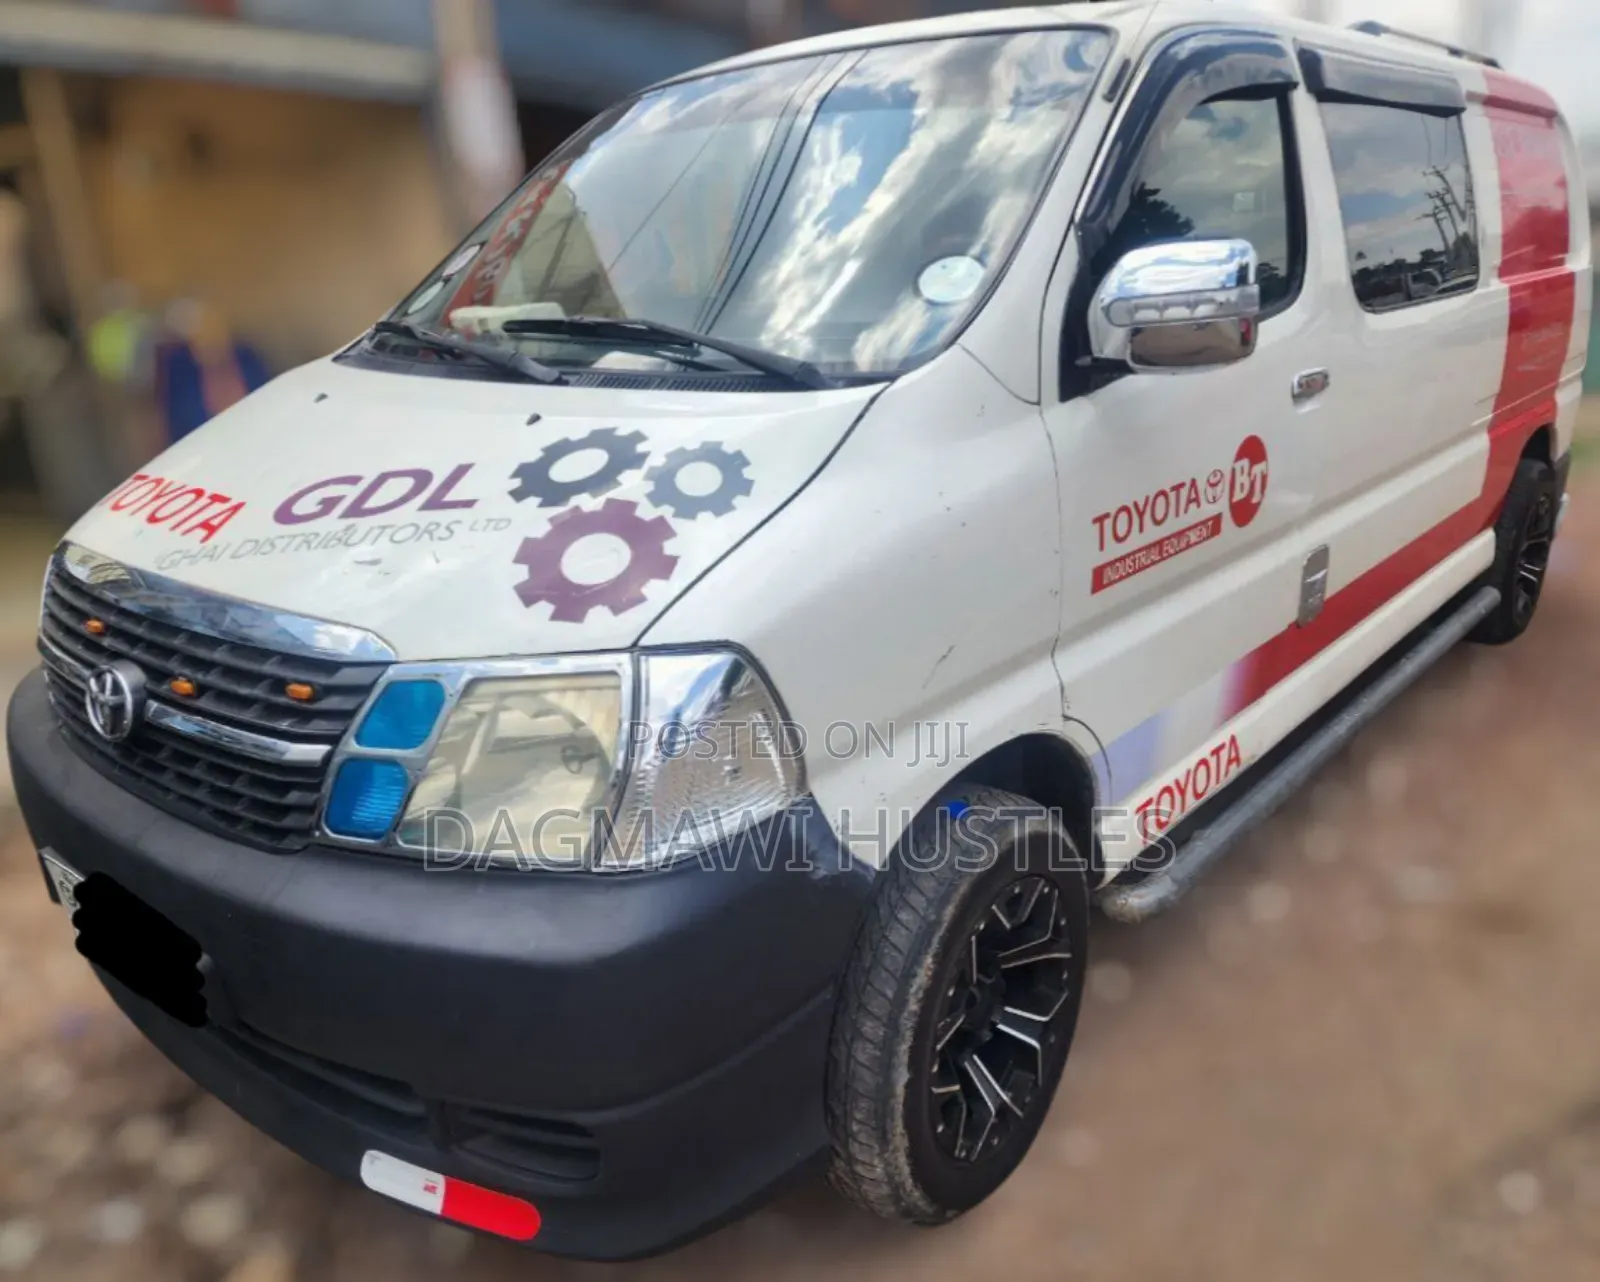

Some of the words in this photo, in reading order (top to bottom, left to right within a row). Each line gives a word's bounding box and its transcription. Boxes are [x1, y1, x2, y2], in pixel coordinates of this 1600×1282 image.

[100, 474, 247, 543] TOYOTA
[273, 463, 479, 525] GDL
[1092, 478, 1201, 552] TOYOTA
[1231, 457, 1267, 504] BT
[229, 521, 462, 559] DISTRIBUTORS
[469, 518, 511, 533] LTD
[1102, 544, 1161, 585] INDUSTRIAL
[1162, 520, 1214, 557] EQUIPMENT
[1134, 734, 1241, 845] TOYOTA
